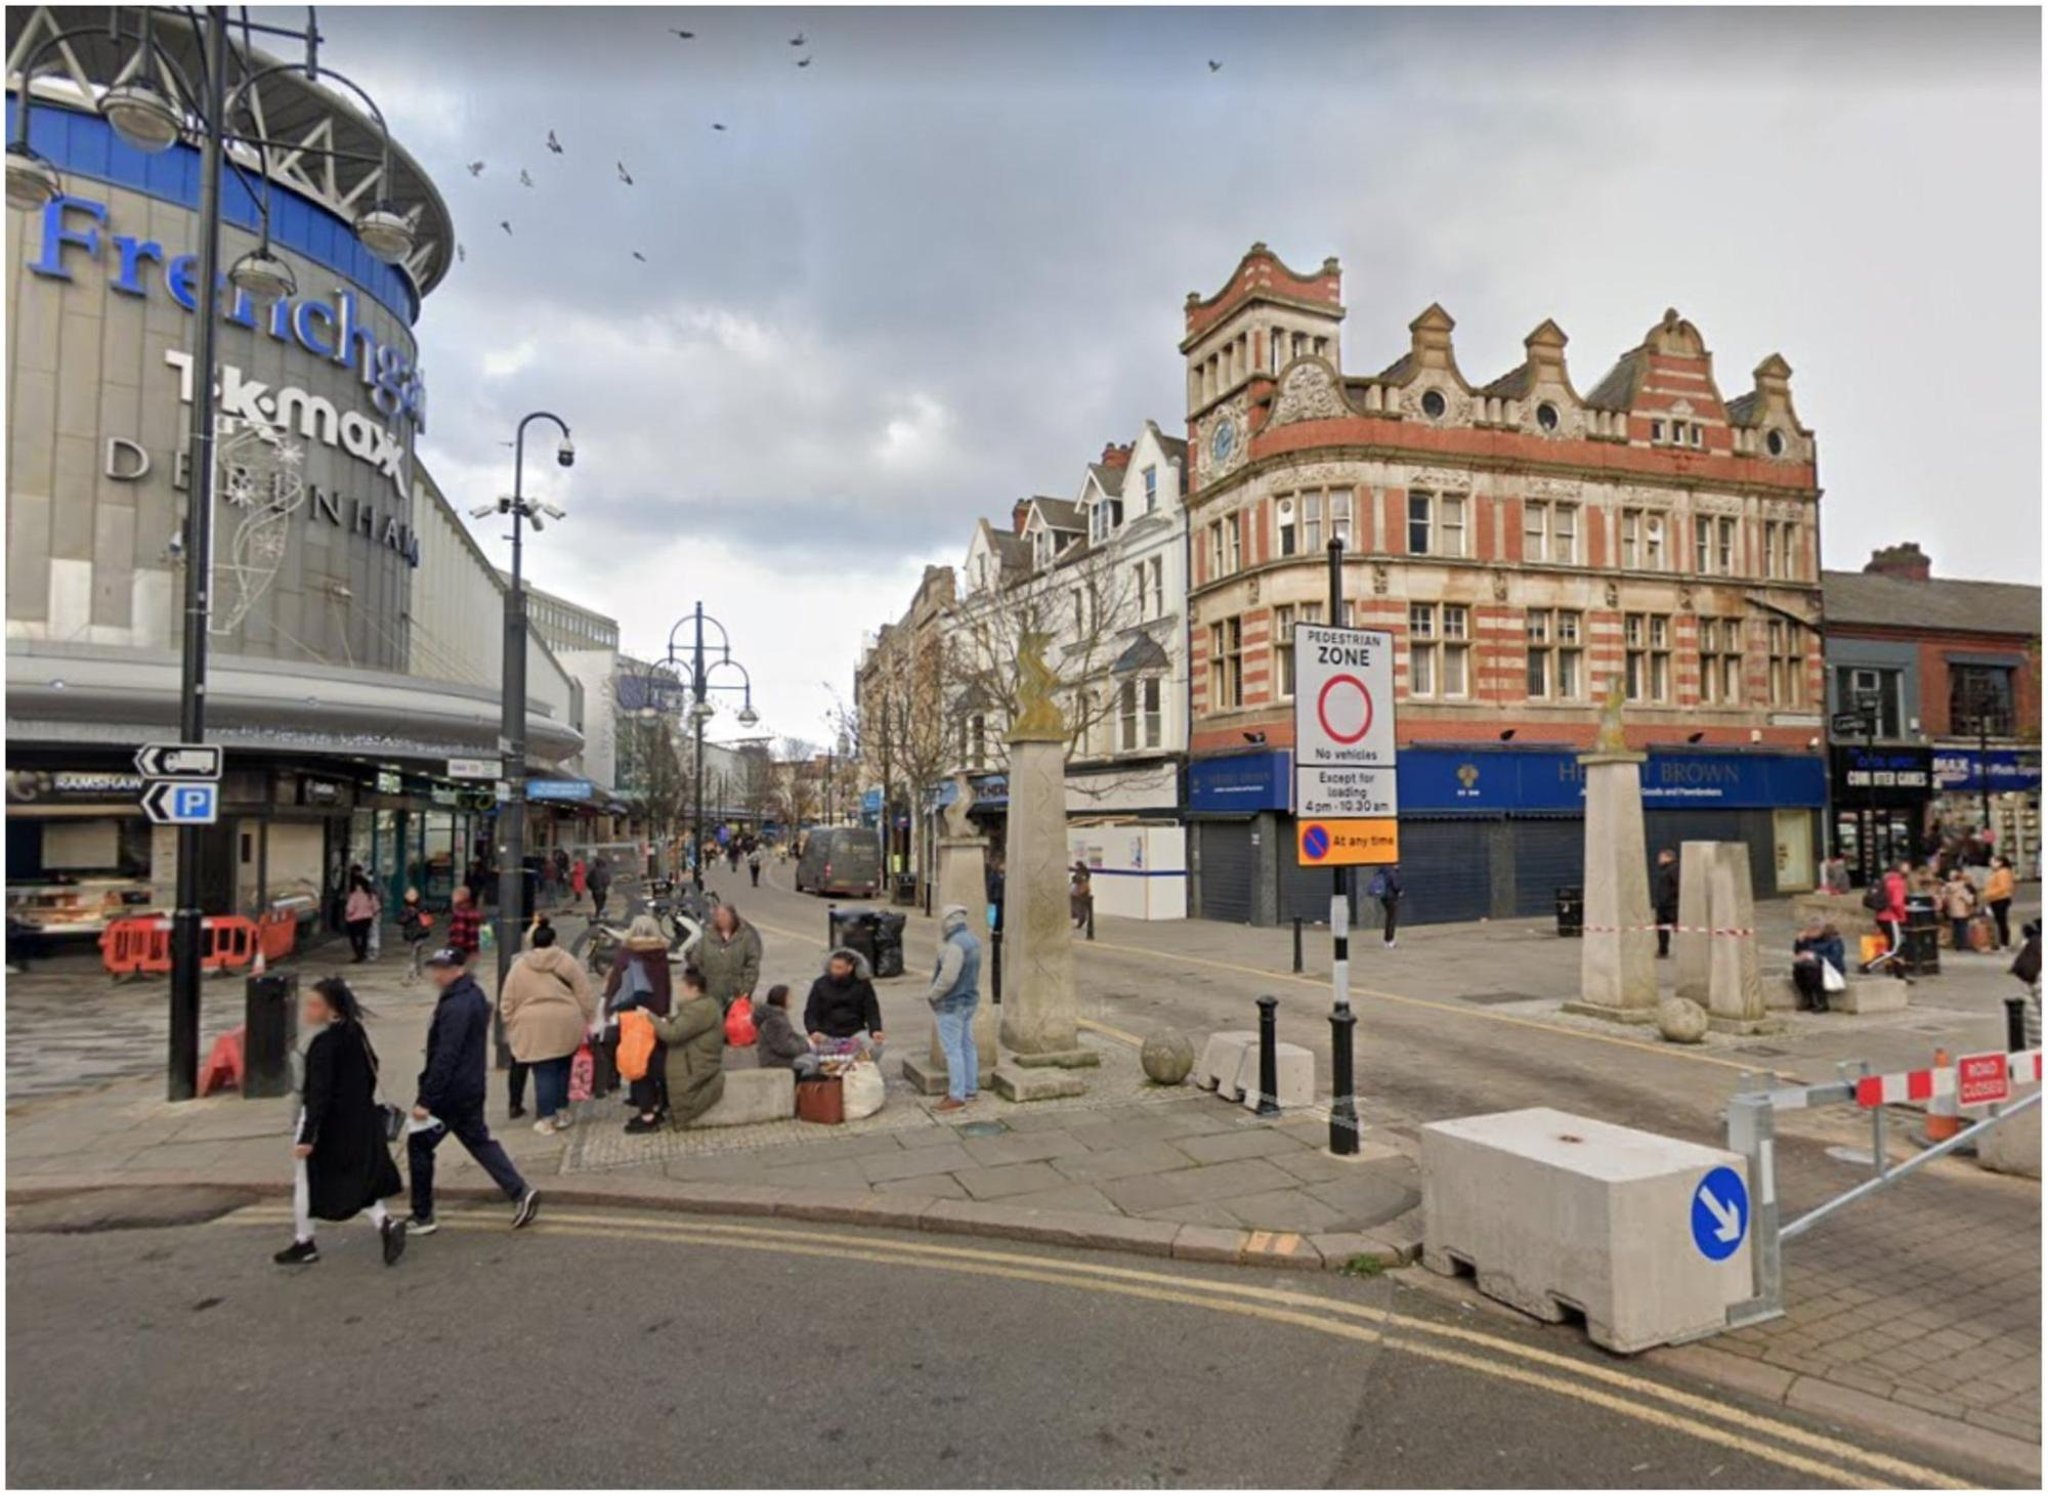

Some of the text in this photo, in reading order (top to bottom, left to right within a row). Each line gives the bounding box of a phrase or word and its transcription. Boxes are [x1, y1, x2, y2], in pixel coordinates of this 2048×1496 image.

[1307, 630, 1381, 646] PEDESTRIAN
[1317, 646, 1370, 667] ZONE
[1316, 748, 1378, 761] No vehicles
[1319, 772, 1375, 784] Except for
[1660, 762, 1740, 783] BROWN
[1328, 787, 1367, 800] loading
[183, 792, 206, 817] P
[1333, 836, 1394, 849] At any time
[1967, 1060, 1997, 1077] ROAD
[1962, 1079, 2004, 1099] CLOSED
